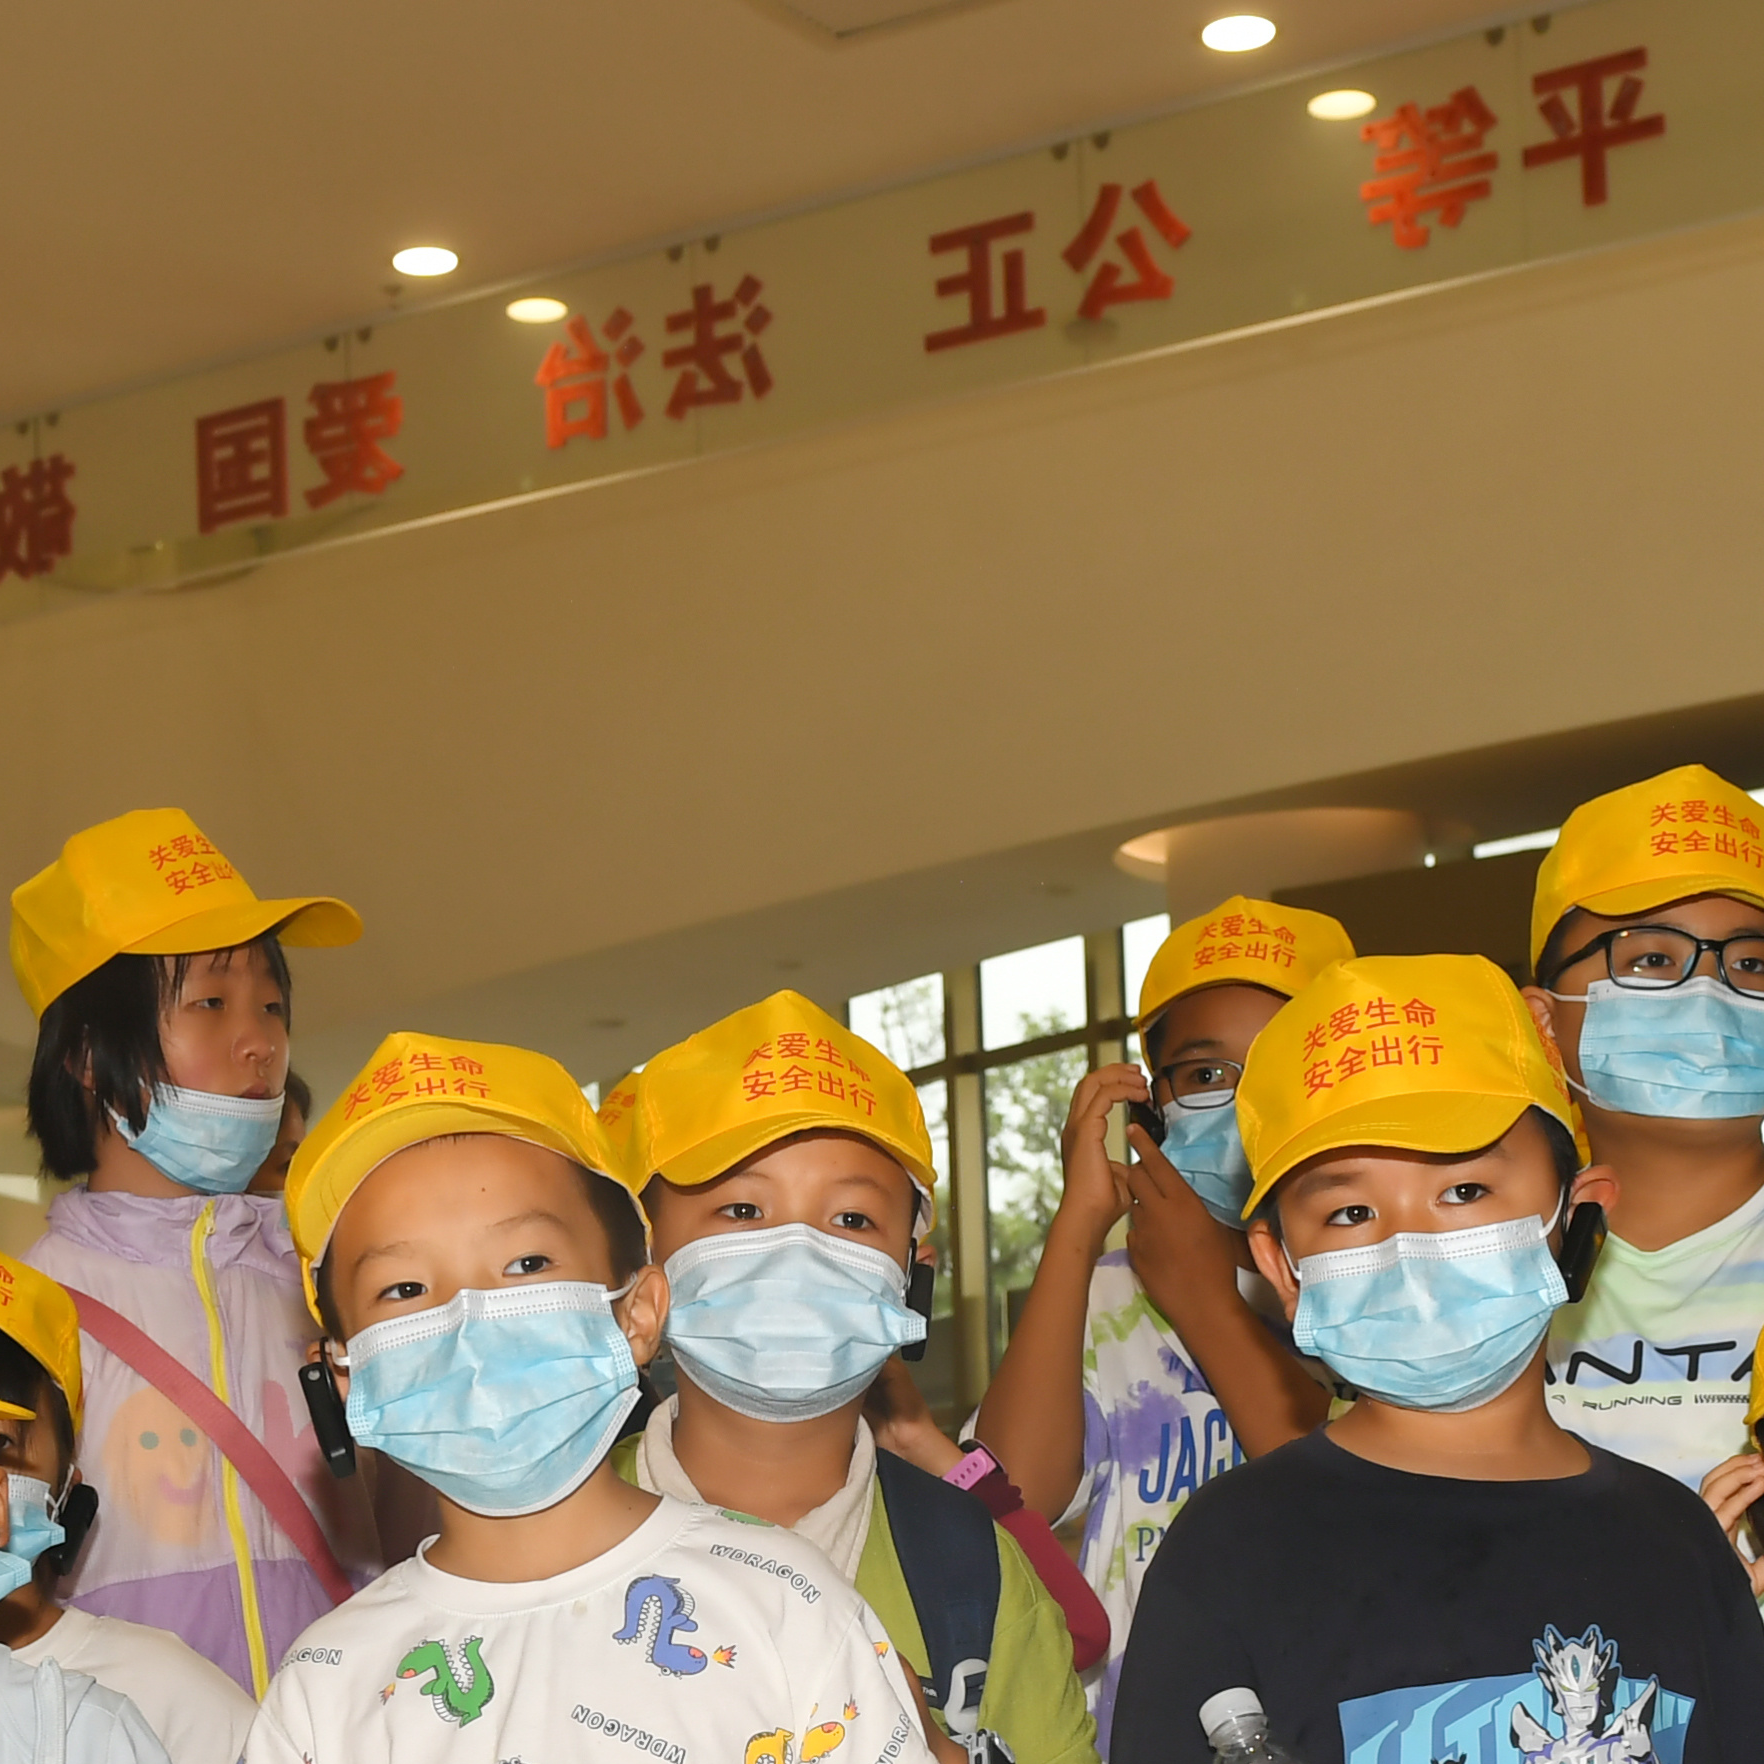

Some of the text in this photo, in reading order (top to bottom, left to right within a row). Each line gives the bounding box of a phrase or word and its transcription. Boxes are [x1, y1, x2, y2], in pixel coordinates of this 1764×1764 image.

[1650, 800, 1760, 840] 关爱生命
[149, 834, 220, 871] 关爱生
[1650, 830, 1764, 868] 安全出行
[165, 861, 235, 895] 安全出
[1196, 914, 1296, 946] 关爱生命
[1193, 941, 1296, 970] 安全出行
[1302, 996, 1436, 1062] 关爱生命
[344, 1052, 485, 1121] 关爱生命
[1303, 1034, 1444, 1099] 安全出行
[372, 1077, 492, 1118] 全出行
[742, 1064, 877, 1116] 安全出行
[1582, 1395, 1682, 1411] RUNNING
[710, 1544, 821, 1604] WDRAGON
